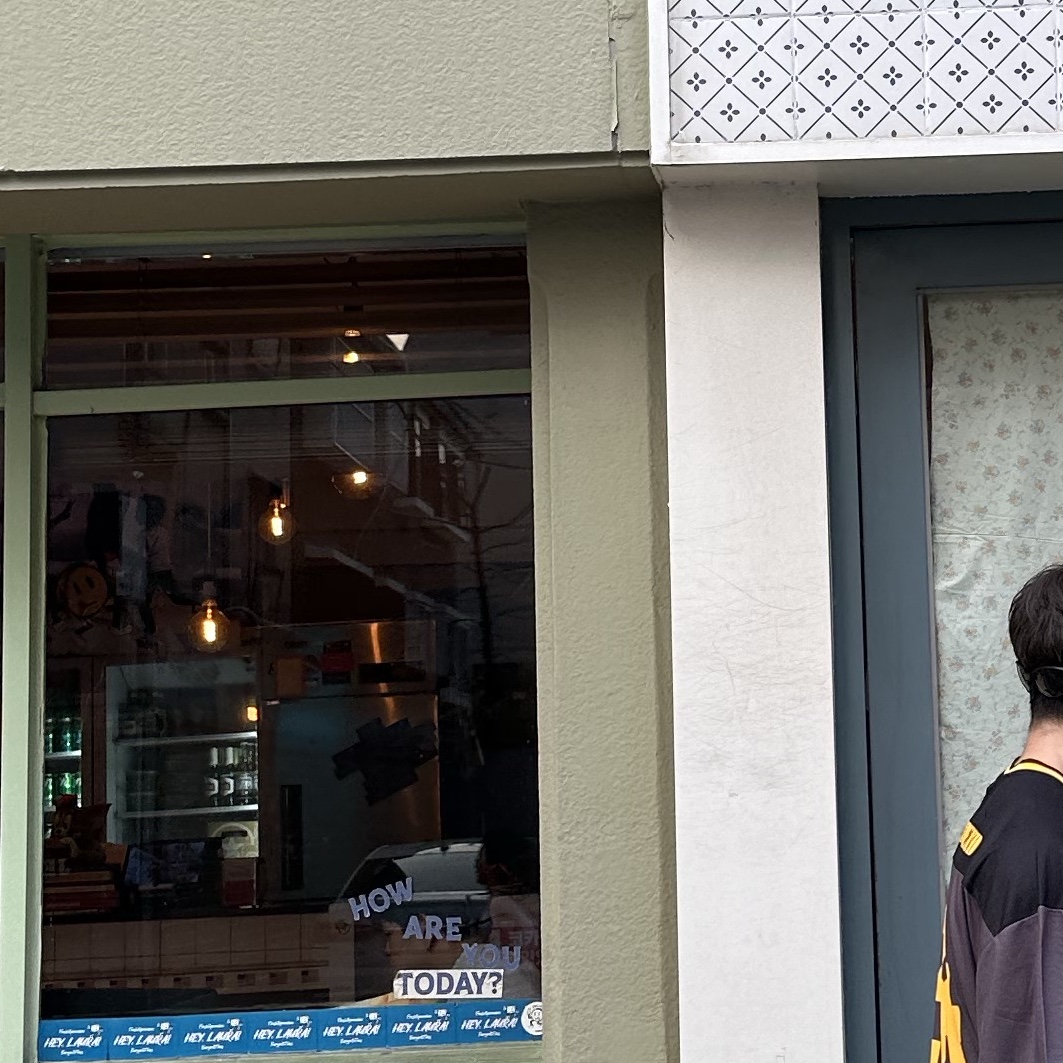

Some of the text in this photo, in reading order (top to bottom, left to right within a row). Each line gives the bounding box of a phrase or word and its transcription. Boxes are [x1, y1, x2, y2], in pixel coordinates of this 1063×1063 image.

[348, 877, 414, 921] HOW
[402, 915, 463, 942] ARE
[461, 942, 522, 970] YOU
[395, 971, 503, 996] TODAY?
